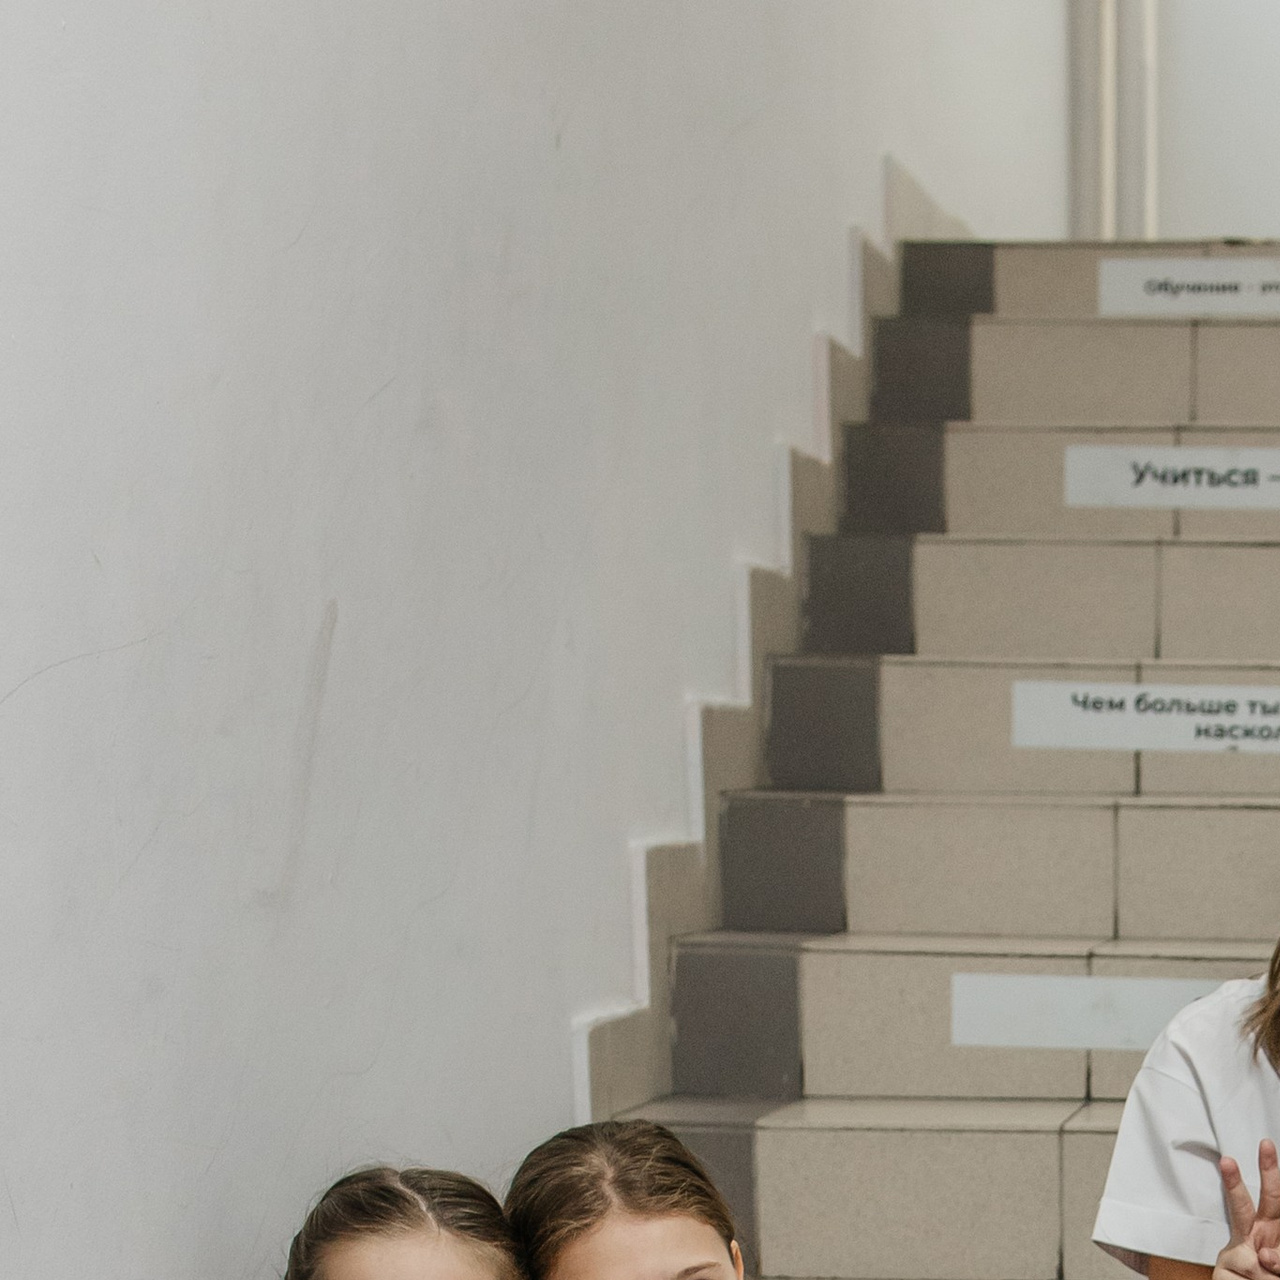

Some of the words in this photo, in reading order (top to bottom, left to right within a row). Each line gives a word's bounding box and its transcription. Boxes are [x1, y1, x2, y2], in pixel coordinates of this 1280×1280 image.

[1131, 462, 1259, 488] Учиться
[1071, 693, 1125, 712] Чем
[1134, 692, 1238, 715] больше
[1249, 698, 1280, 715] ты
